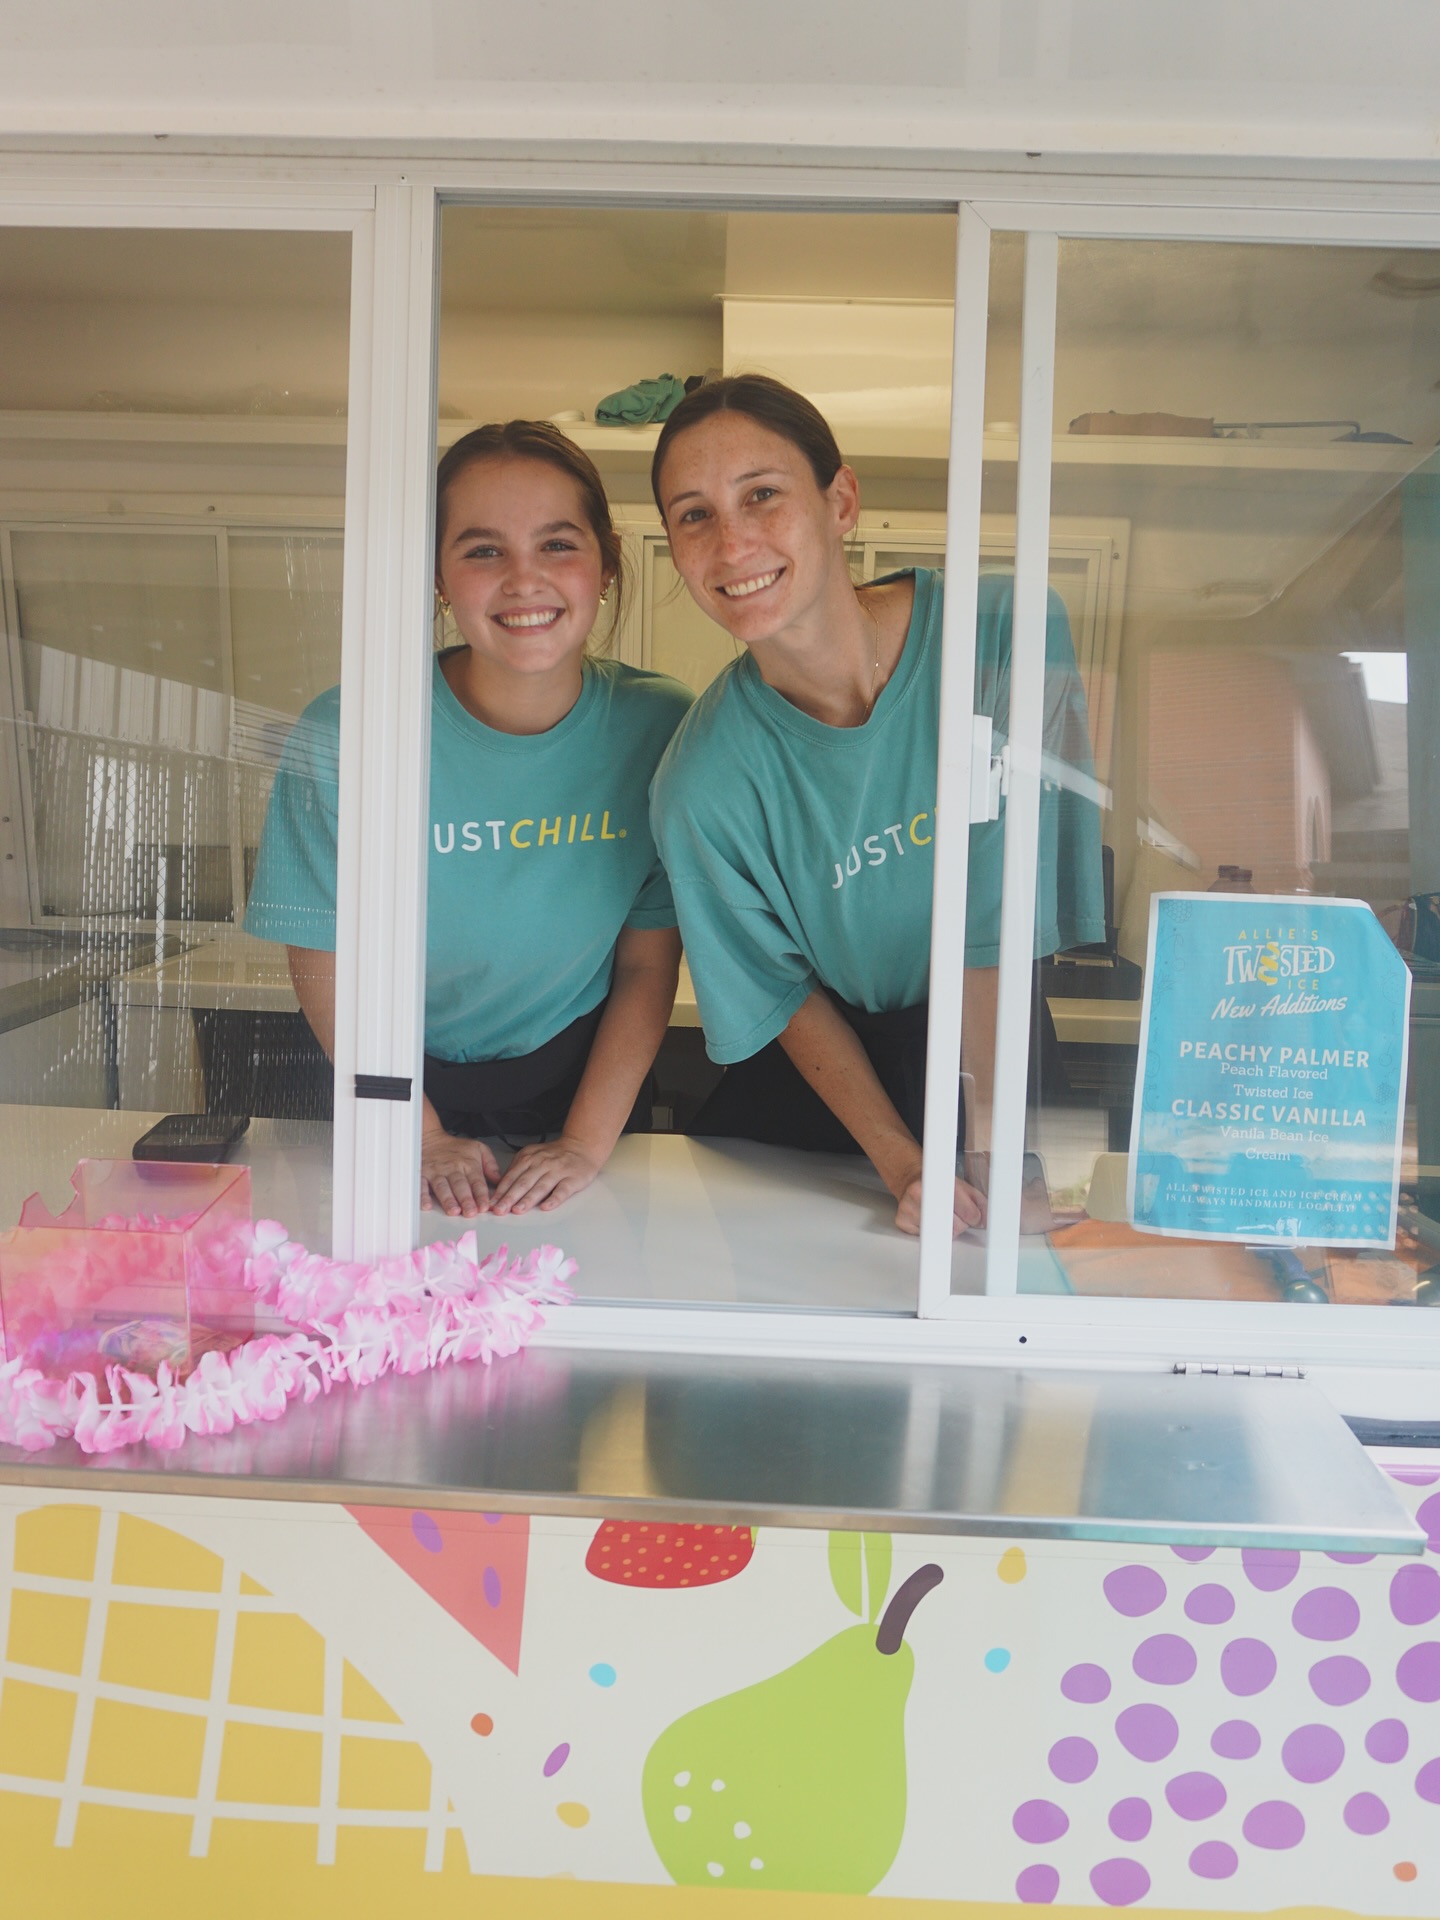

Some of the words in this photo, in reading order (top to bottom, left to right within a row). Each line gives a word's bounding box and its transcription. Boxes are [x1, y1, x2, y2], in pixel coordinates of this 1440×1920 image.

[1288, 979, 1319, 990] ICE
[1210, 996, 1256, 1020] New
[1260, 992, 1348, 1017] Additions
[1179, 1040, 1273, 1063] PEACHY
[1279, 1047, 1370, 1068] PALMER
[1220, 1062, 1264, 1077] Peach
[1268, 1065, 1329, 1081] Flavored
[1233, 1083, 1288, 1098] Twisted
[1293, 1087, 1314, 1100] Ice
[1171, 1099, 1266, 1122] CLASSIC
[1271, 1105, 1367, 1127] VANILLA
[1269, 1128, 1304, 1142] Bean
[1307, 1130, 1330, 1143] Ice
[1245, 1147, 1291, 1161] Cream
[1165, 1193, 1177, 1201] IS
[1180, 1194, 1226, 1206] ALWAYS
[1229, 1198, 1295, 1209] HANDMADE
[1166, 1183, 1189, 1192] ALL
[1191, 1184, 1247, 1196] TWISTED
[1249, 1188, 1269, 1197] ICE
[1272, 1189, 1297, 1199] AND
[1300, 1191, 1321, 1200] ICE
[1324, 1192, 1362, 1202] CREAM
